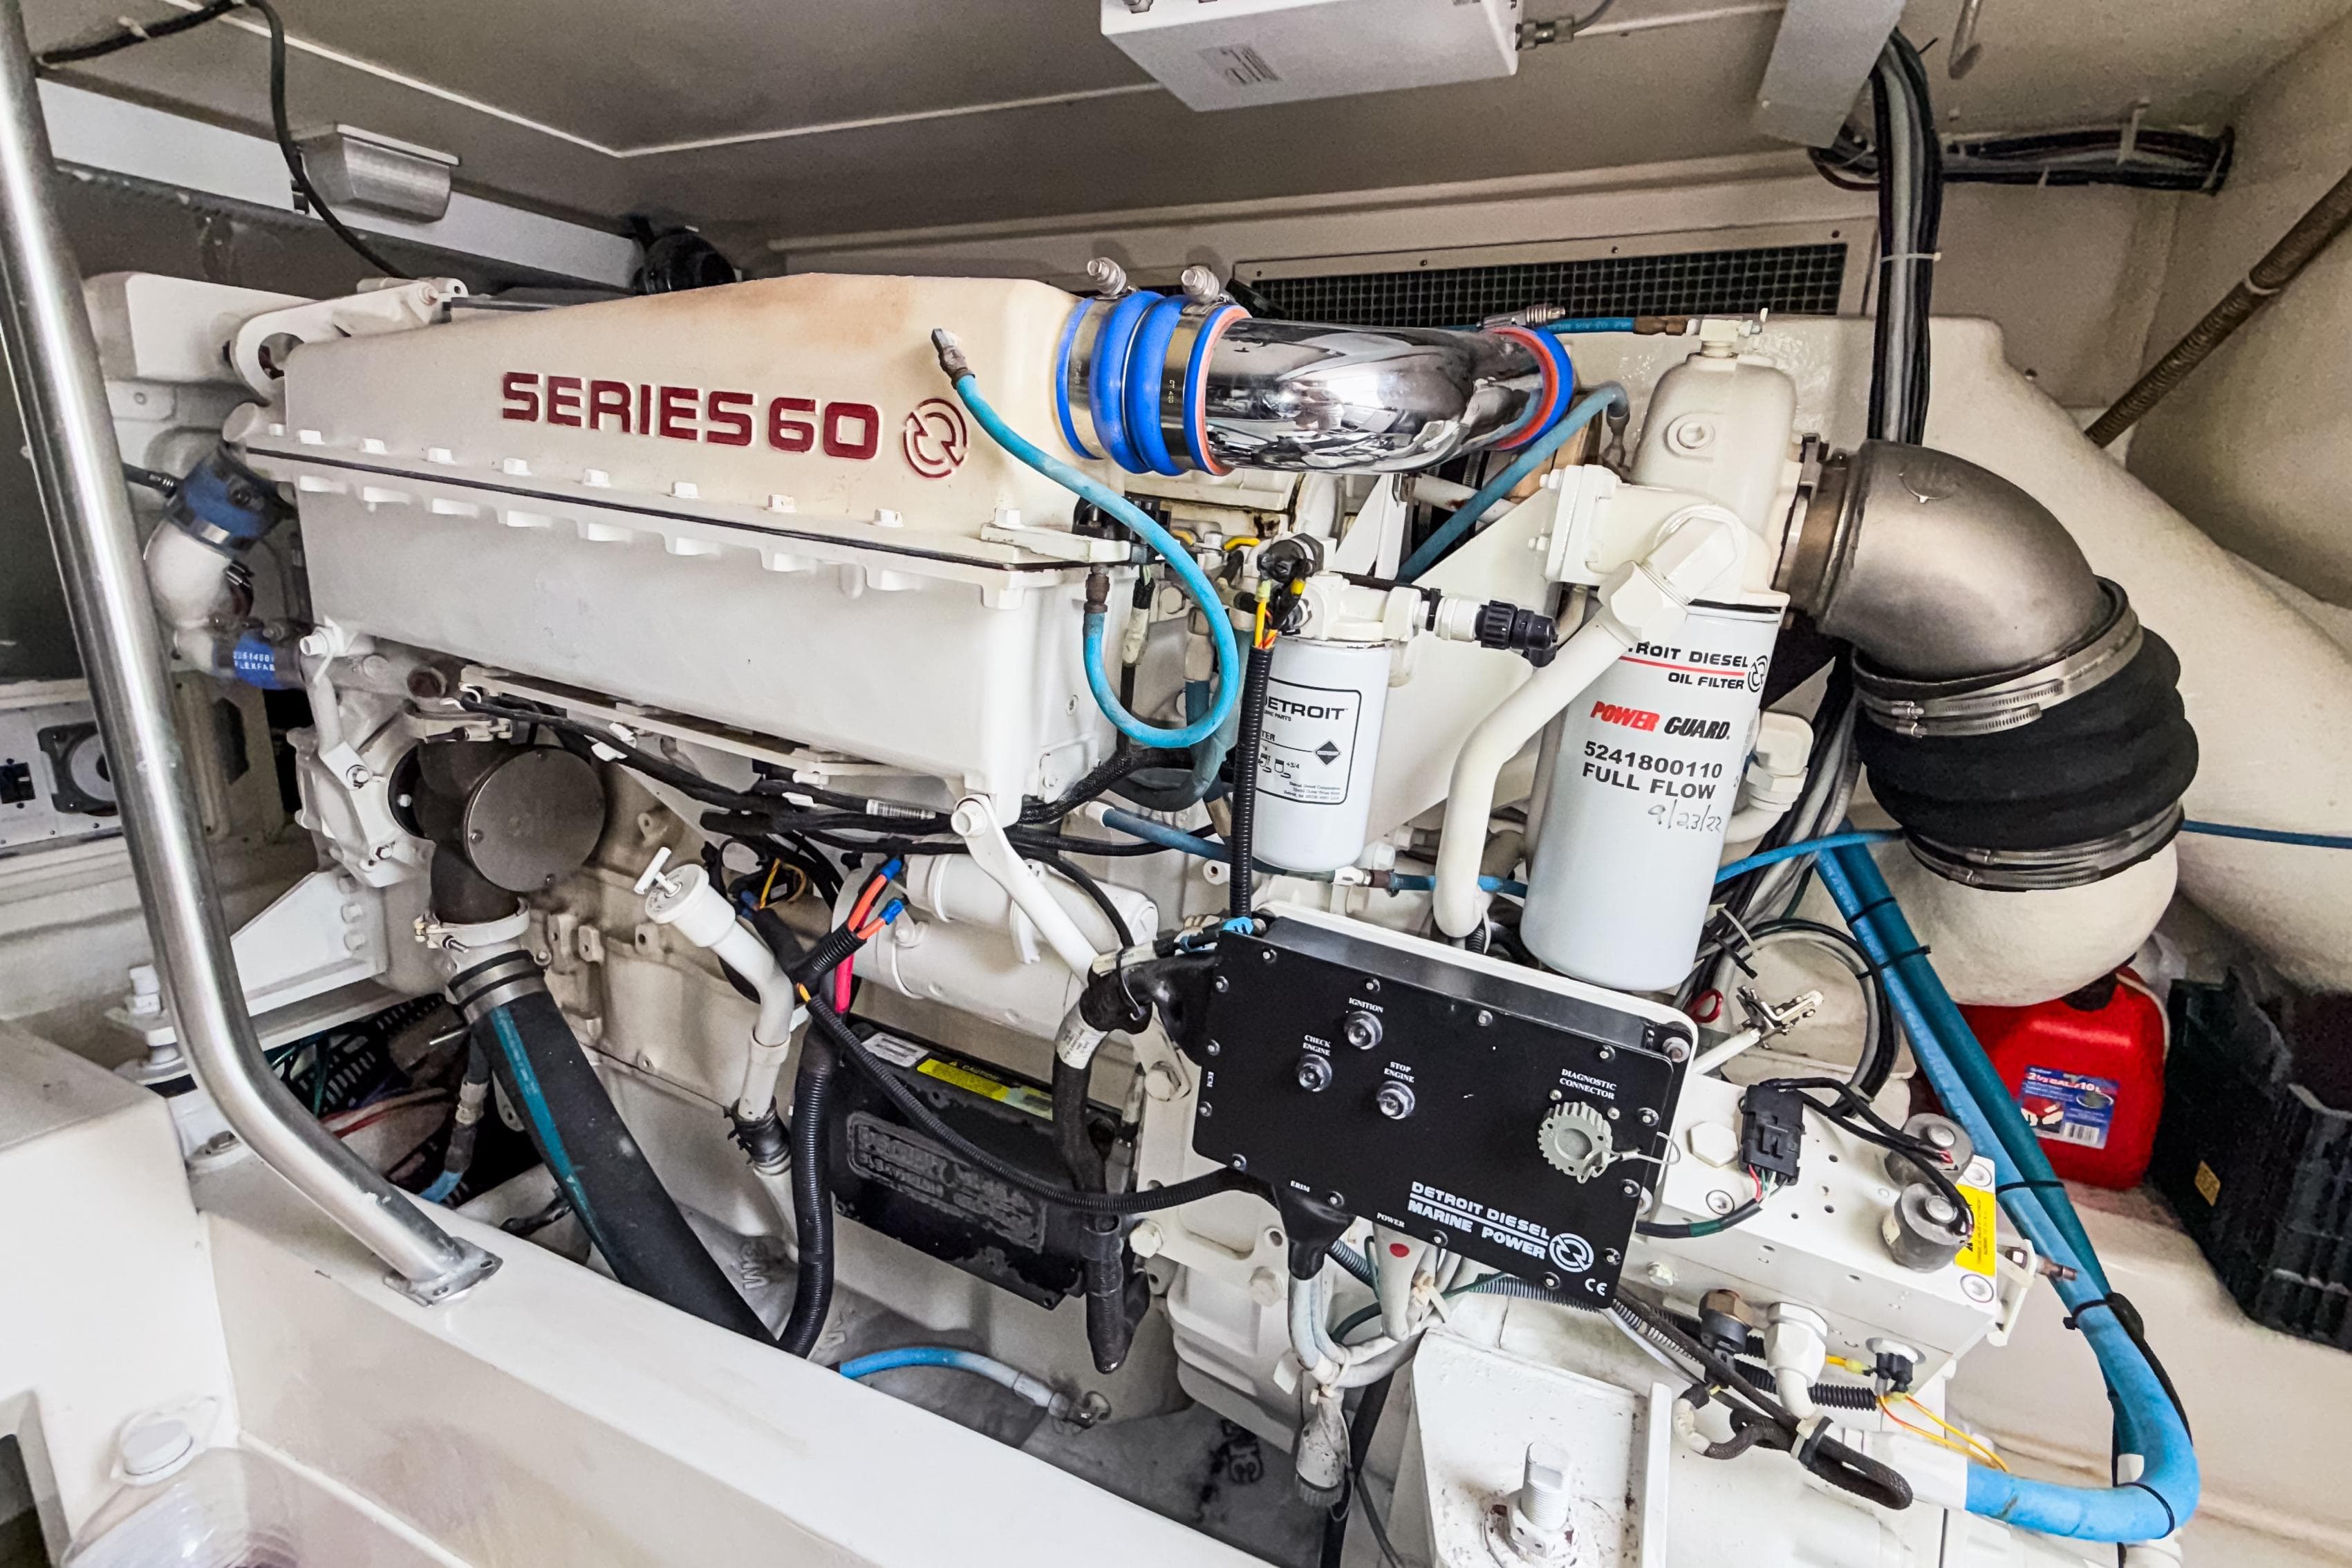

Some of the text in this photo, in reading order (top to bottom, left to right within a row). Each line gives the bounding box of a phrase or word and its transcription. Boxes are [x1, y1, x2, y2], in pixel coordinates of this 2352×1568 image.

[503, 371, 880, 461] SERIES 60
[1628, 641, 1748, 668] ROIT DIESEL
[1668, 672, 1745, 690] OIL FILTER
[1265, 696, 1345, 720] ETROIT
[1590, 700, 1661, 733] POWER
[1584, 740, 1723, 778] 5241800110
[1582, 762, 1640, 791] FULL
[1650, 778, 1716, 800] FLOW
[1348, 997, 1383, 1014] IGNITION
[1303, 1042, 1331, 1056] ENGINE
[1304, 1034, 1331, 1048] CHECK
[1383, 1067, 1415, 1083] ENGINE
[1390, 1061, 1412, 1073] STOP
[1559, 1077, 1616, 1101] CONNECTOR
[1561, 1068, 1617, 1091] DIAGNOSTIC
[1376, 1212, 1406, 1229] POWER
[1411, 1180, 1550, 1240] DETROIT DIESEL
[1407, 1199, 1547, 1260] MARINE POWER
[1585, 1278, 1608, 1296] CE
